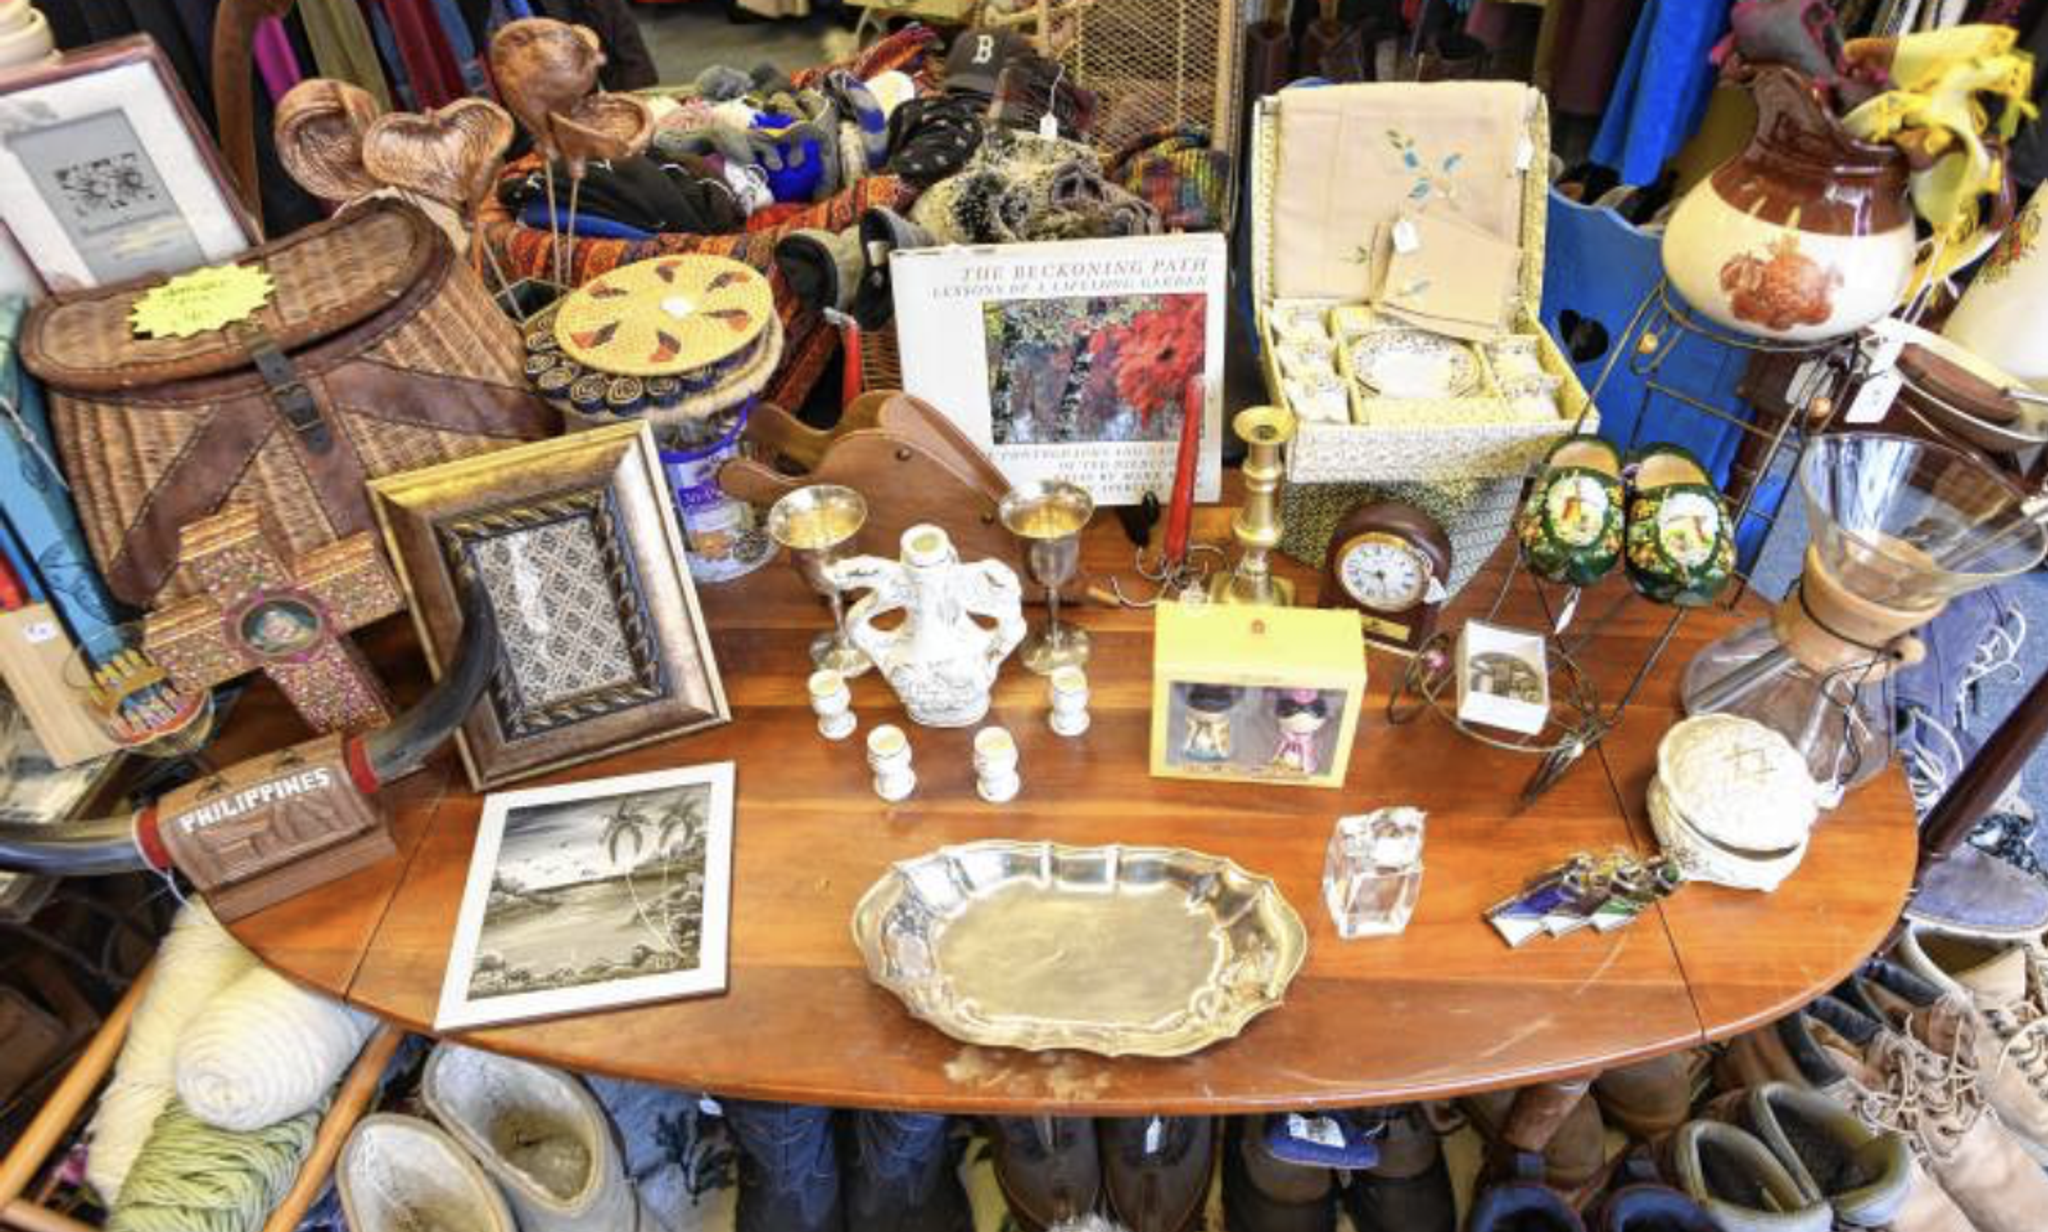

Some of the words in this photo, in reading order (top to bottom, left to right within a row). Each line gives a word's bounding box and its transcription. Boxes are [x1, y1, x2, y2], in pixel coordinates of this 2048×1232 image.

[971, 34, 994, 64] B
[963, 266, 1003, 281] THE
[1013, 260, 1143, 279] BECKONING
[1151, 256, 1208, 273] PATH
[178, 767, 331, 833] PHILIPPINES
